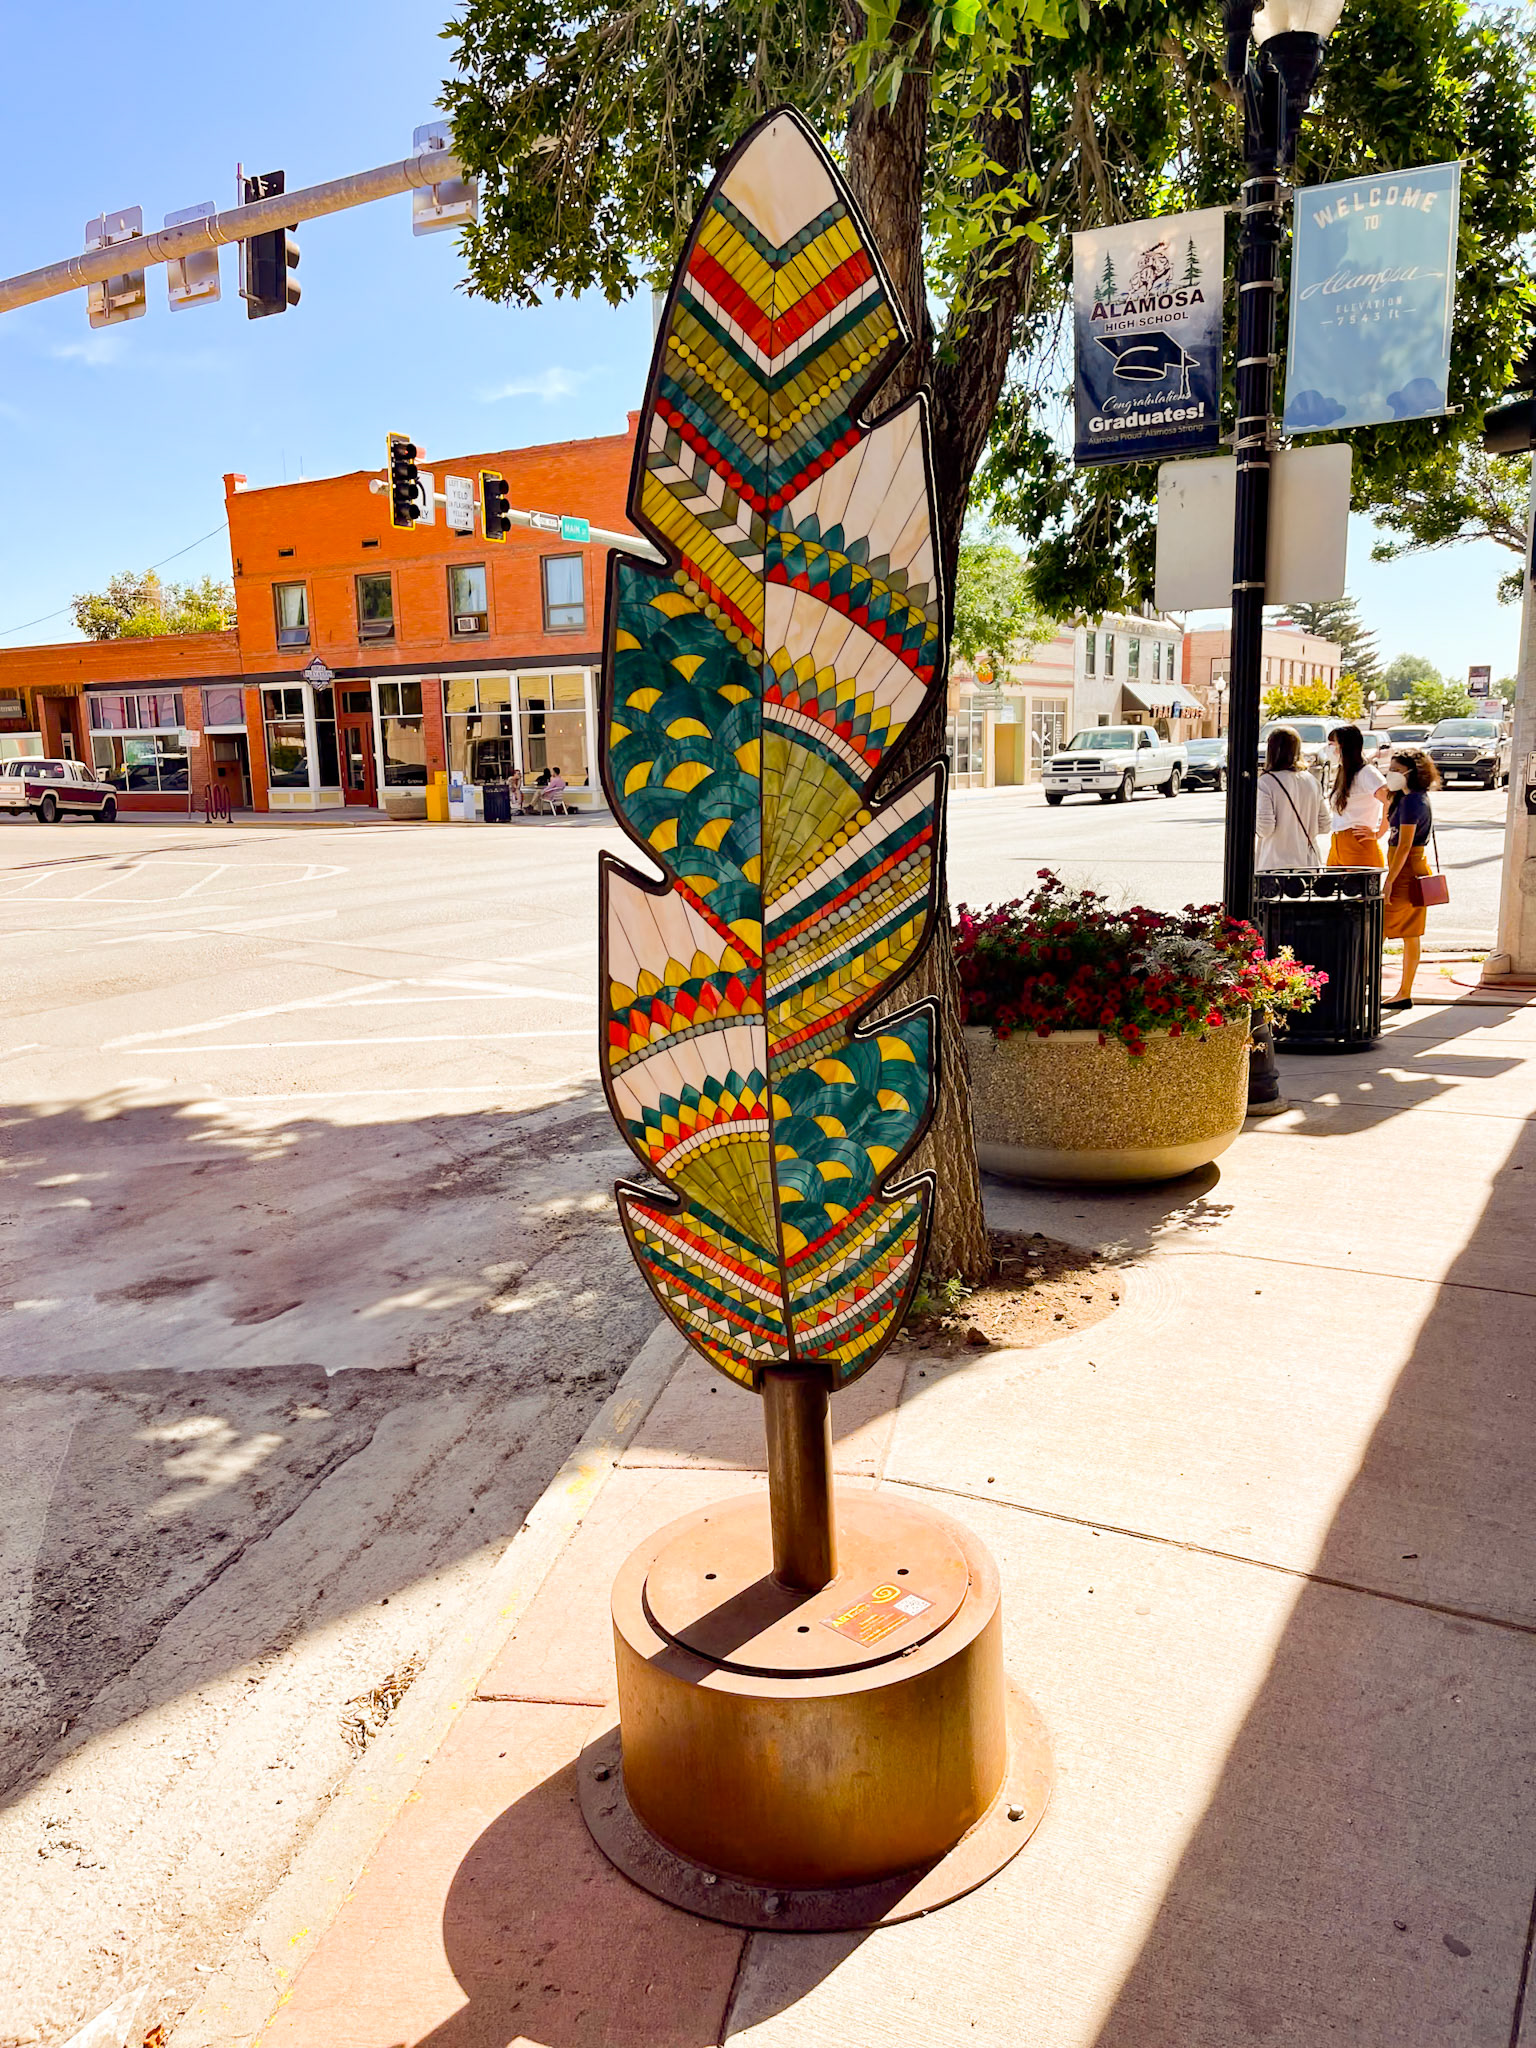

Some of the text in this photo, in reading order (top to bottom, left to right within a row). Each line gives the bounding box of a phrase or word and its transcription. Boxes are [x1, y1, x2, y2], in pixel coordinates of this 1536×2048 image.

[1313, 186, 1438, 229] WELCOME
[1364, 214, 1379, 231] TO
[1299, 266, 1444, 301] Alamosa
[1091, 289, 1205, 321] ALAMOSA
[1335, 296, 1403, 313] ELEVATION
[1104, 311, 1189, 333] HIGH SCHOOL
[1101, 389, 1192, 414] Congratulations
[1088, 402, 1205, 433] Graduates!
[1088, 434, 1120, 445] Alamosa
[1145, 428, 1177, 437] Alamosa
[452, 490, 468, 500] YIELD
[564, 524, 580, 535] MAIN
